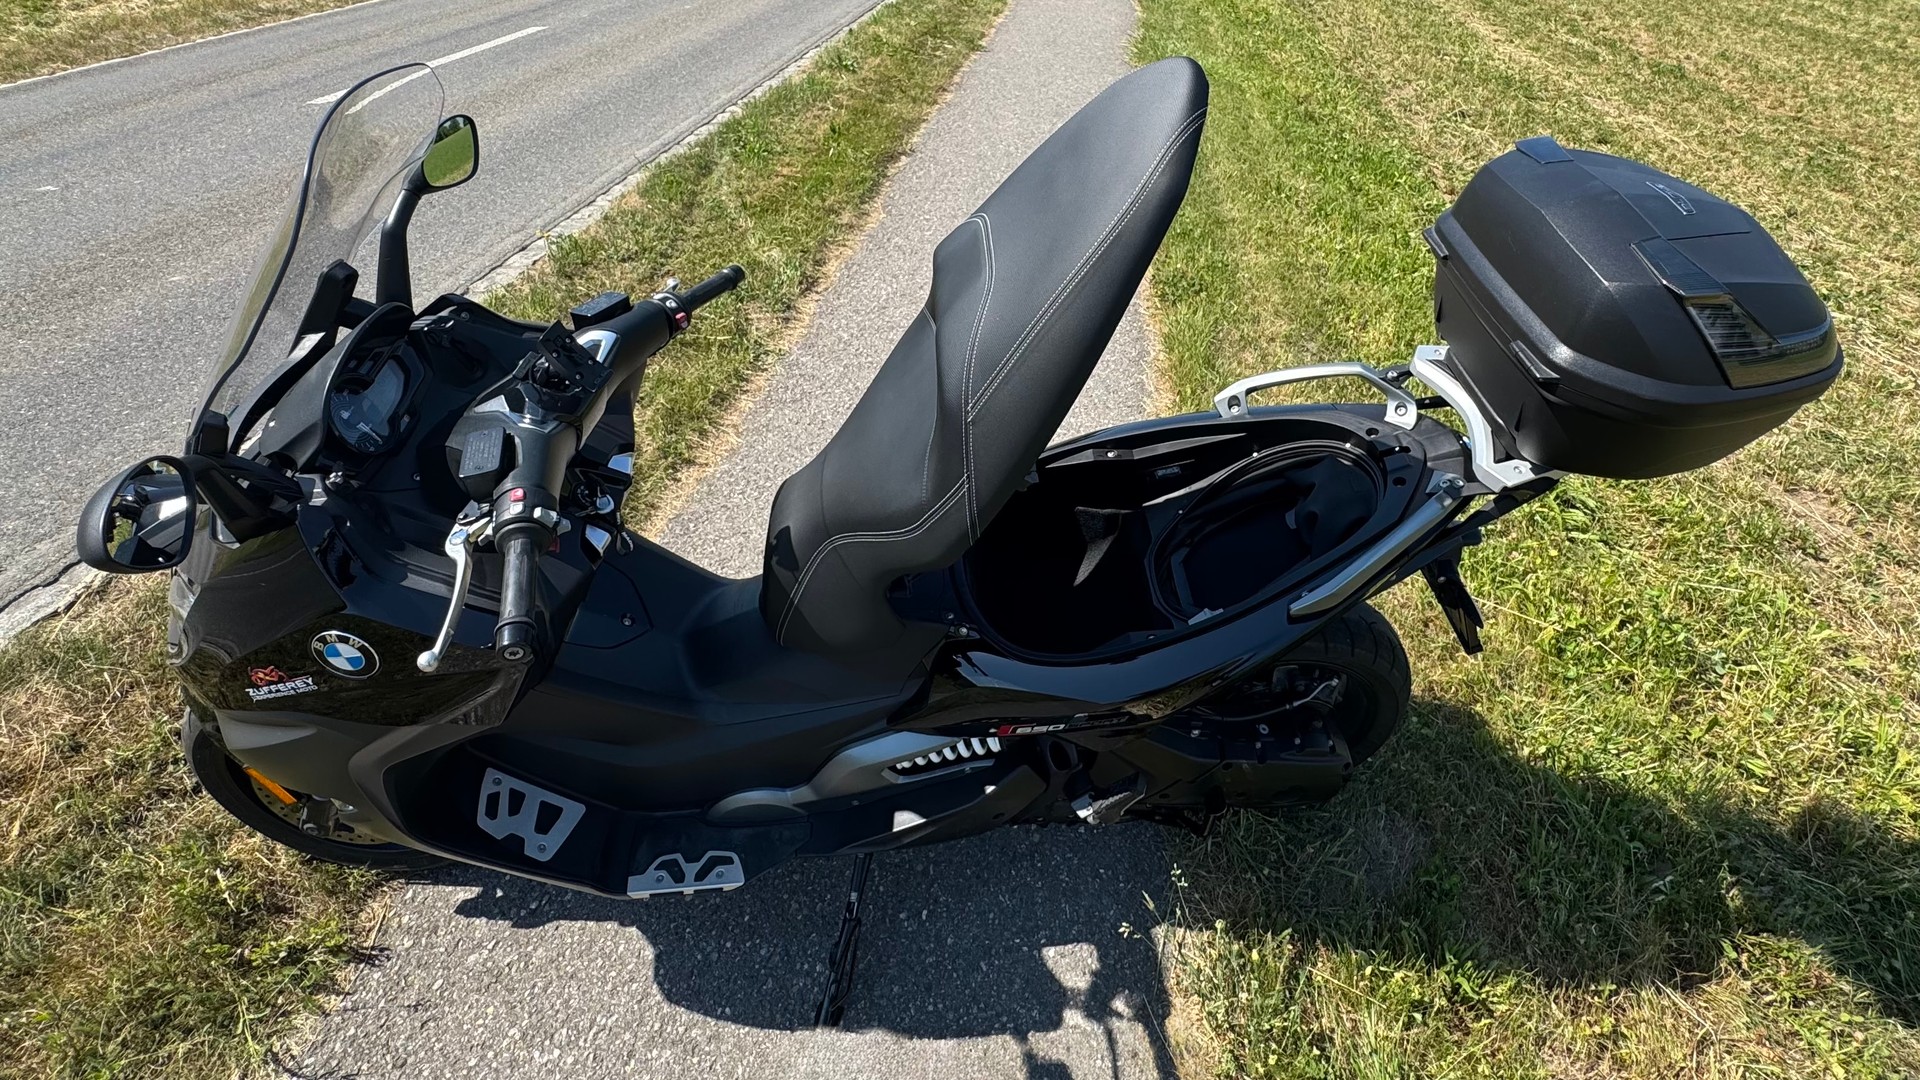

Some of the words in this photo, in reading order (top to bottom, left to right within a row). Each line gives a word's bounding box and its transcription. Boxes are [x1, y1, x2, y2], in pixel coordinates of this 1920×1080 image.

[313, 633, 361, 650] BMW
[245, 677, 314, 696] ZUFFEREY
[296, 685, 318, 695] MOTO
